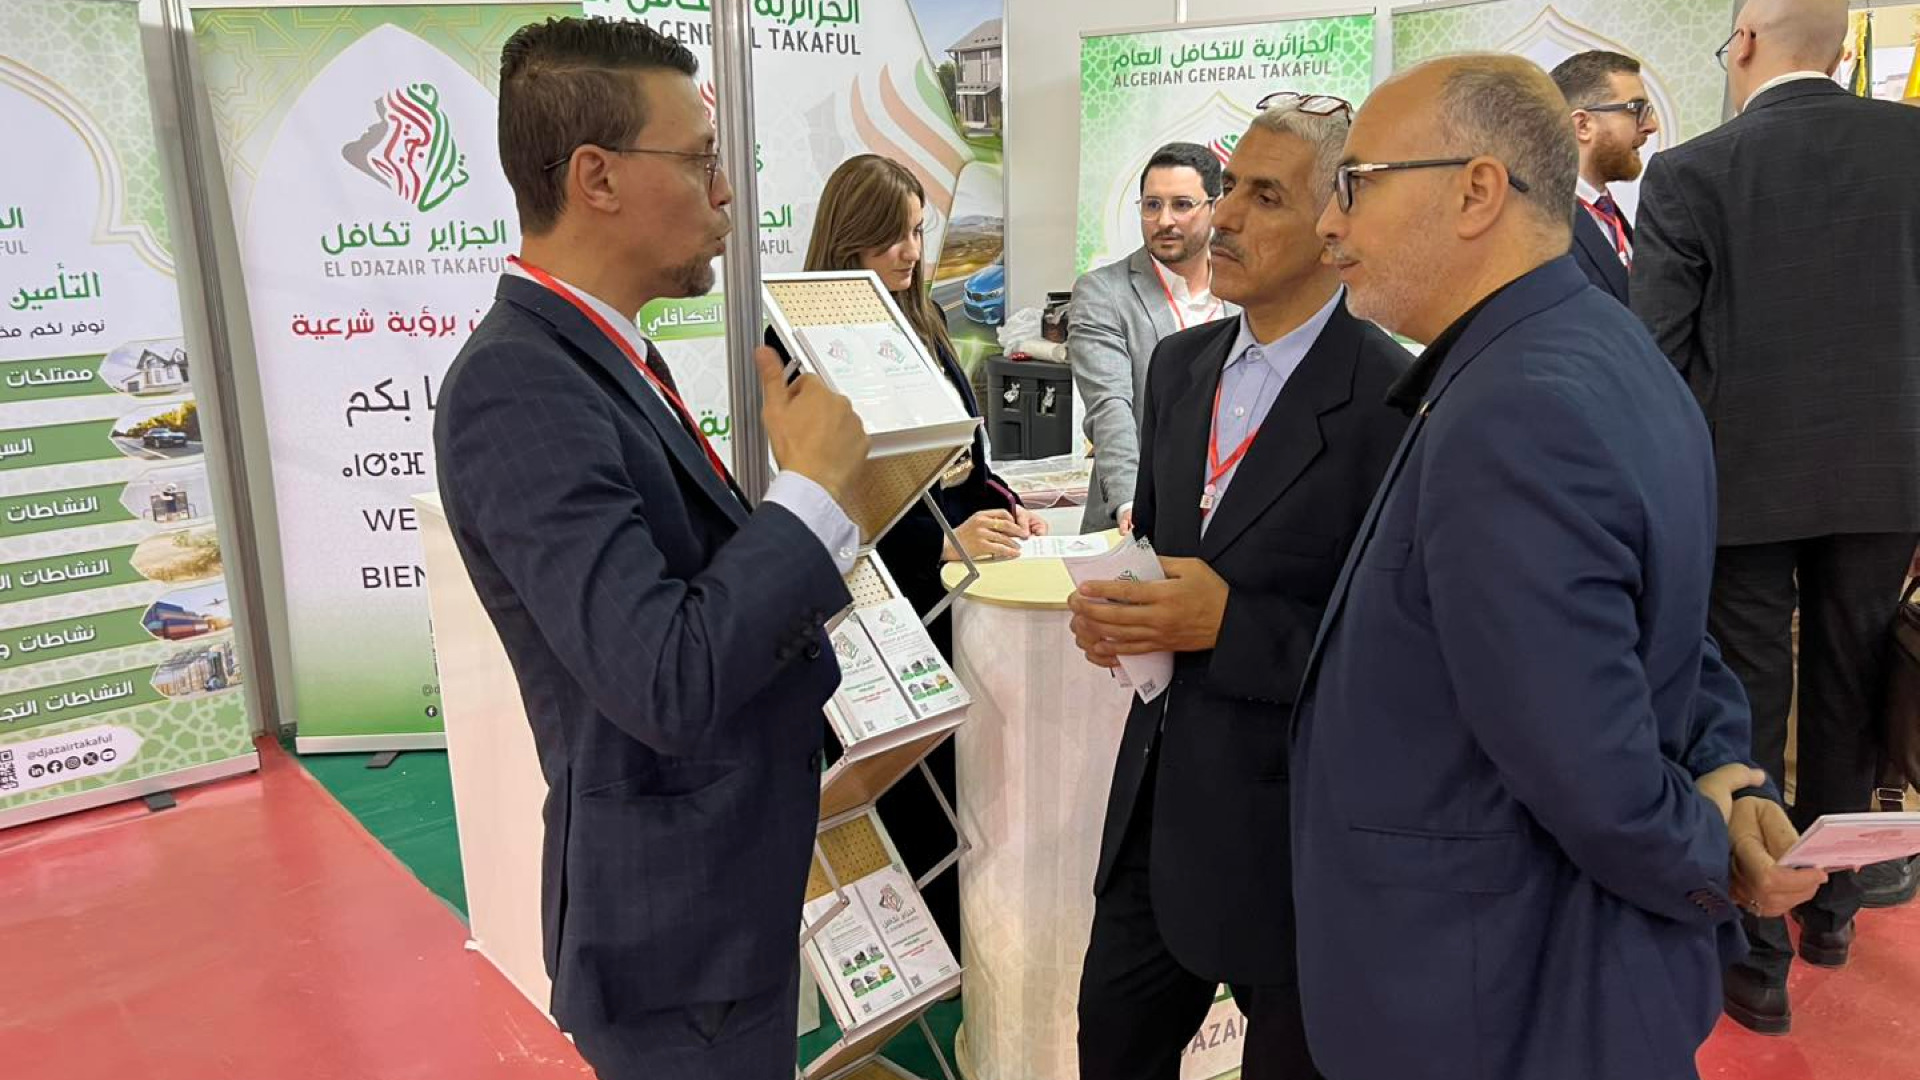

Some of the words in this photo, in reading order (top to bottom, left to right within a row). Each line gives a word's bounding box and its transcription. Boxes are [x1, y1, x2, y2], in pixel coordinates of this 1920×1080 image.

[768, 28, 861, 55] TAKAFUL
[1170, 40, 1244, 68] للتكافل
[1253, 32, 1334, 61] الجزائرية
[1112, 45, 1162, 72] العام
[1112, 69, 1184, 88] ALGERIAN
[1188, 64, 1257, 84] GENERAL
[1261, 60, 1333, 79] TAKAFUL
[321, 221, 410, 256] تكافل
[324, 261, 345, 278] EL
[351, 259, 426, 276] DJAZAIR
[10, 262, 100, 310] التأمين
[30, 322, 63, 339] لكم
[292, 308, 374, 340] شرعية
[388, 306, 456, 337] برؤية
[647, 304, 723, 336] التكافلي
[6, 367, 93, 388] ممتلكات
[347, 378, 410, 427] بكم
[7, 496, 98, 521] النشاطات
[363, 508, 417, 531] WE
[20, 559, 110, 586] النشاطات
[19, 624, 95, 652] نشاطات
[46, 680, 133, 711] النشاطات
[27, 733, 113, 760] @djazairtakaful
